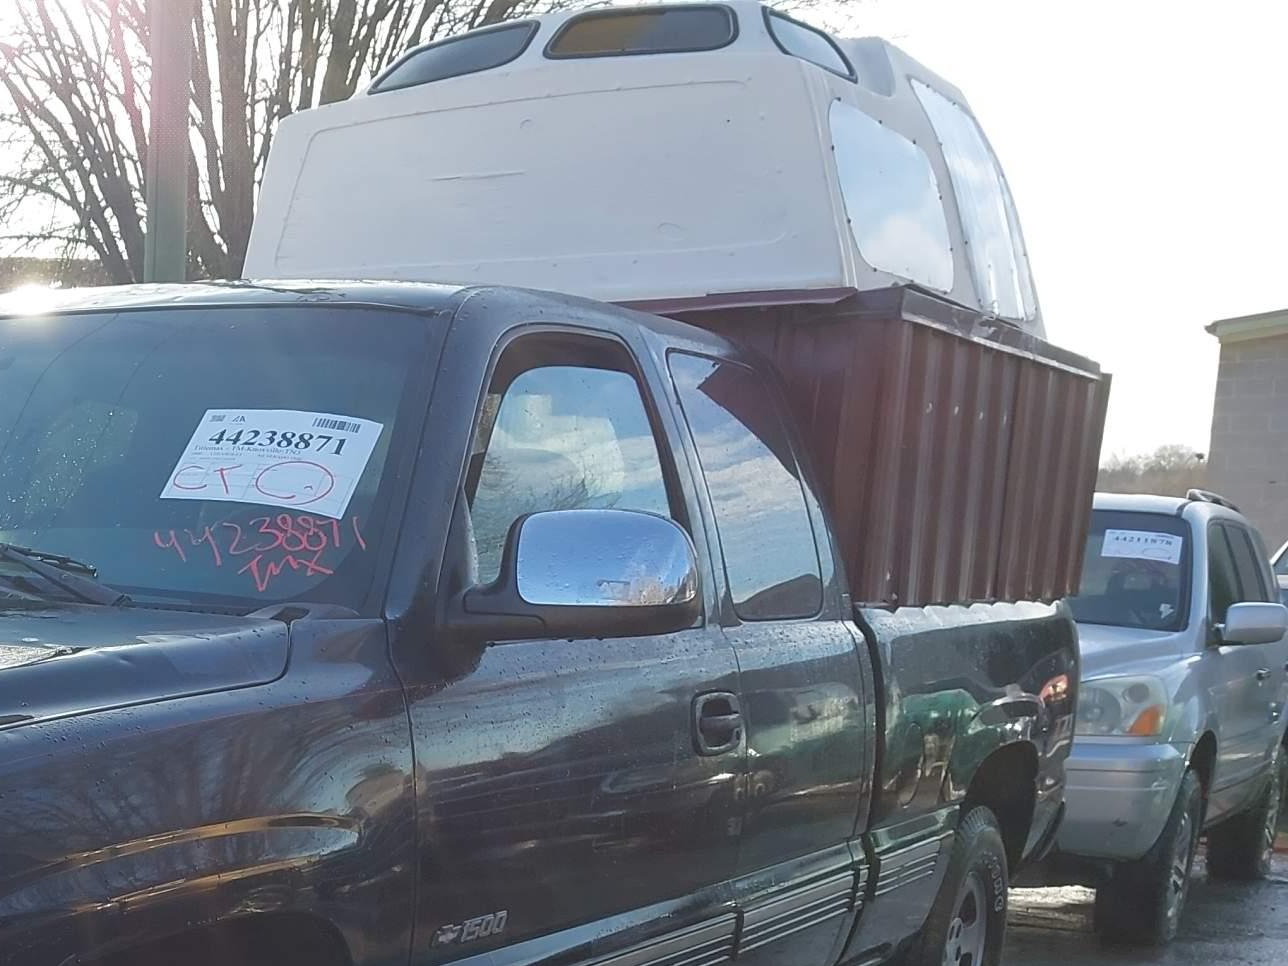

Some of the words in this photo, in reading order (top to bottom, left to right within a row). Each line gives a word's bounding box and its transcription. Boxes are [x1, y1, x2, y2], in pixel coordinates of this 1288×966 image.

[208, 428, 348, 457] 44238871
[153, 513, 367, 567] 44238871
[461, 910, 508, 943] 1500
